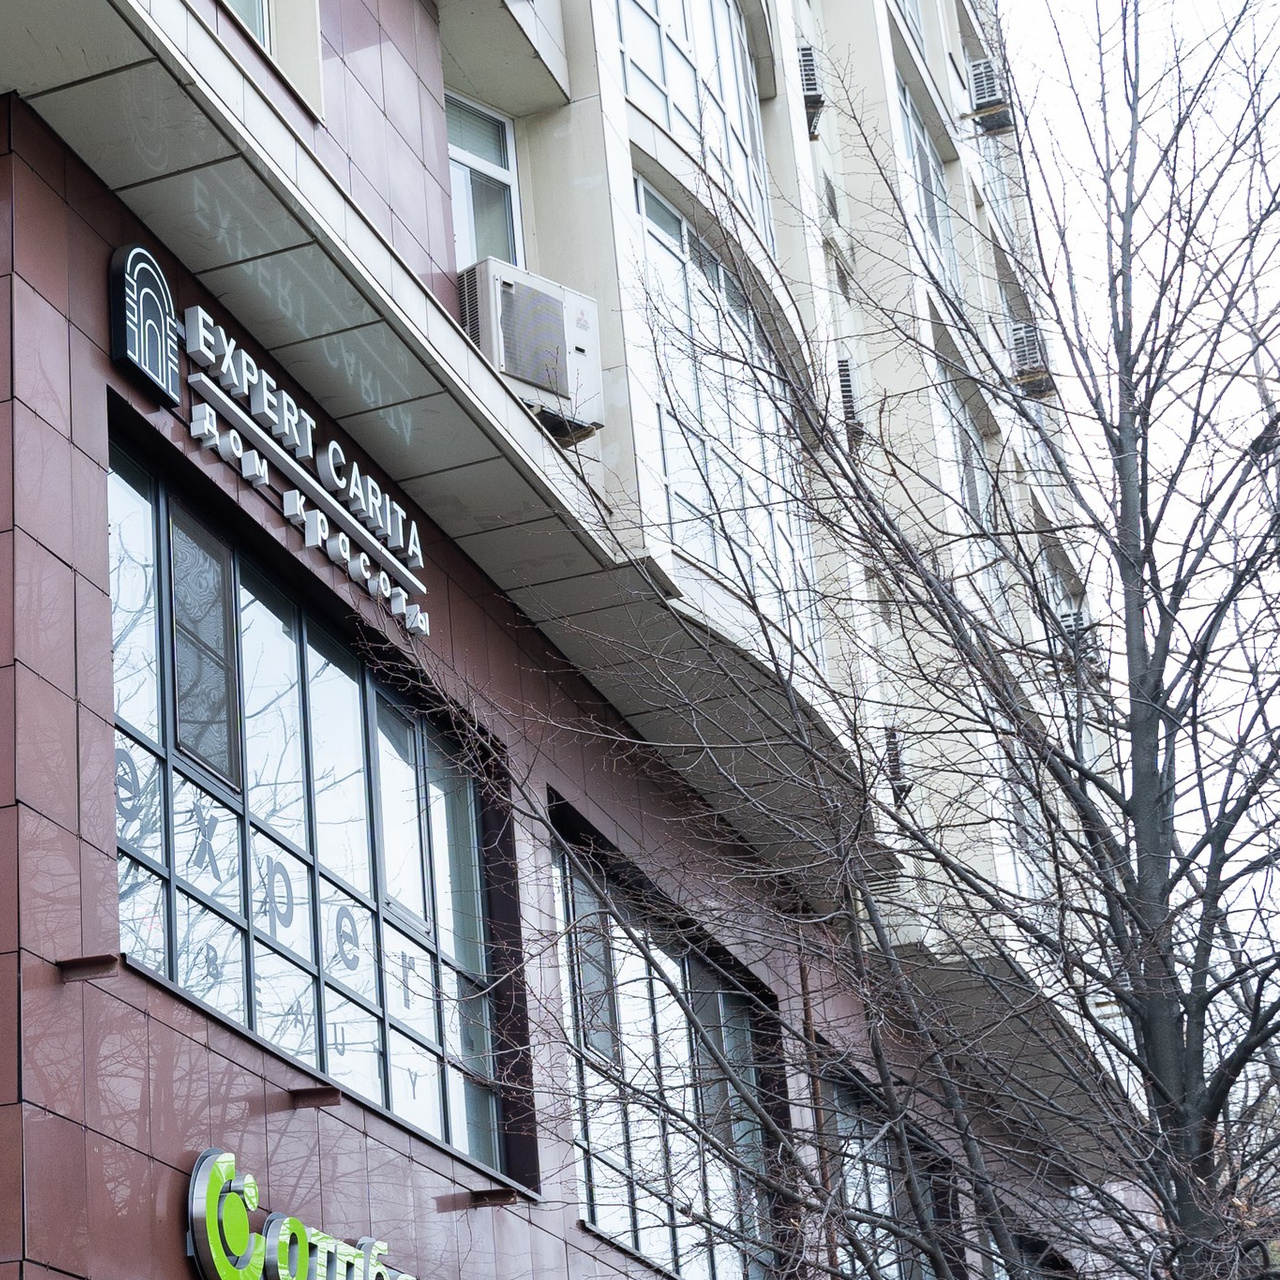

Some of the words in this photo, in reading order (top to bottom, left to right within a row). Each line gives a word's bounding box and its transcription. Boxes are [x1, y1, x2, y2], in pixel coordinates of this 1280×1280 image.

[187, 305, 316, 462] EXPERT
[318, 440, 425, 569] CARITA
[192, 402, 270, 488] дом
[283, 489, 430, 637] красоты
